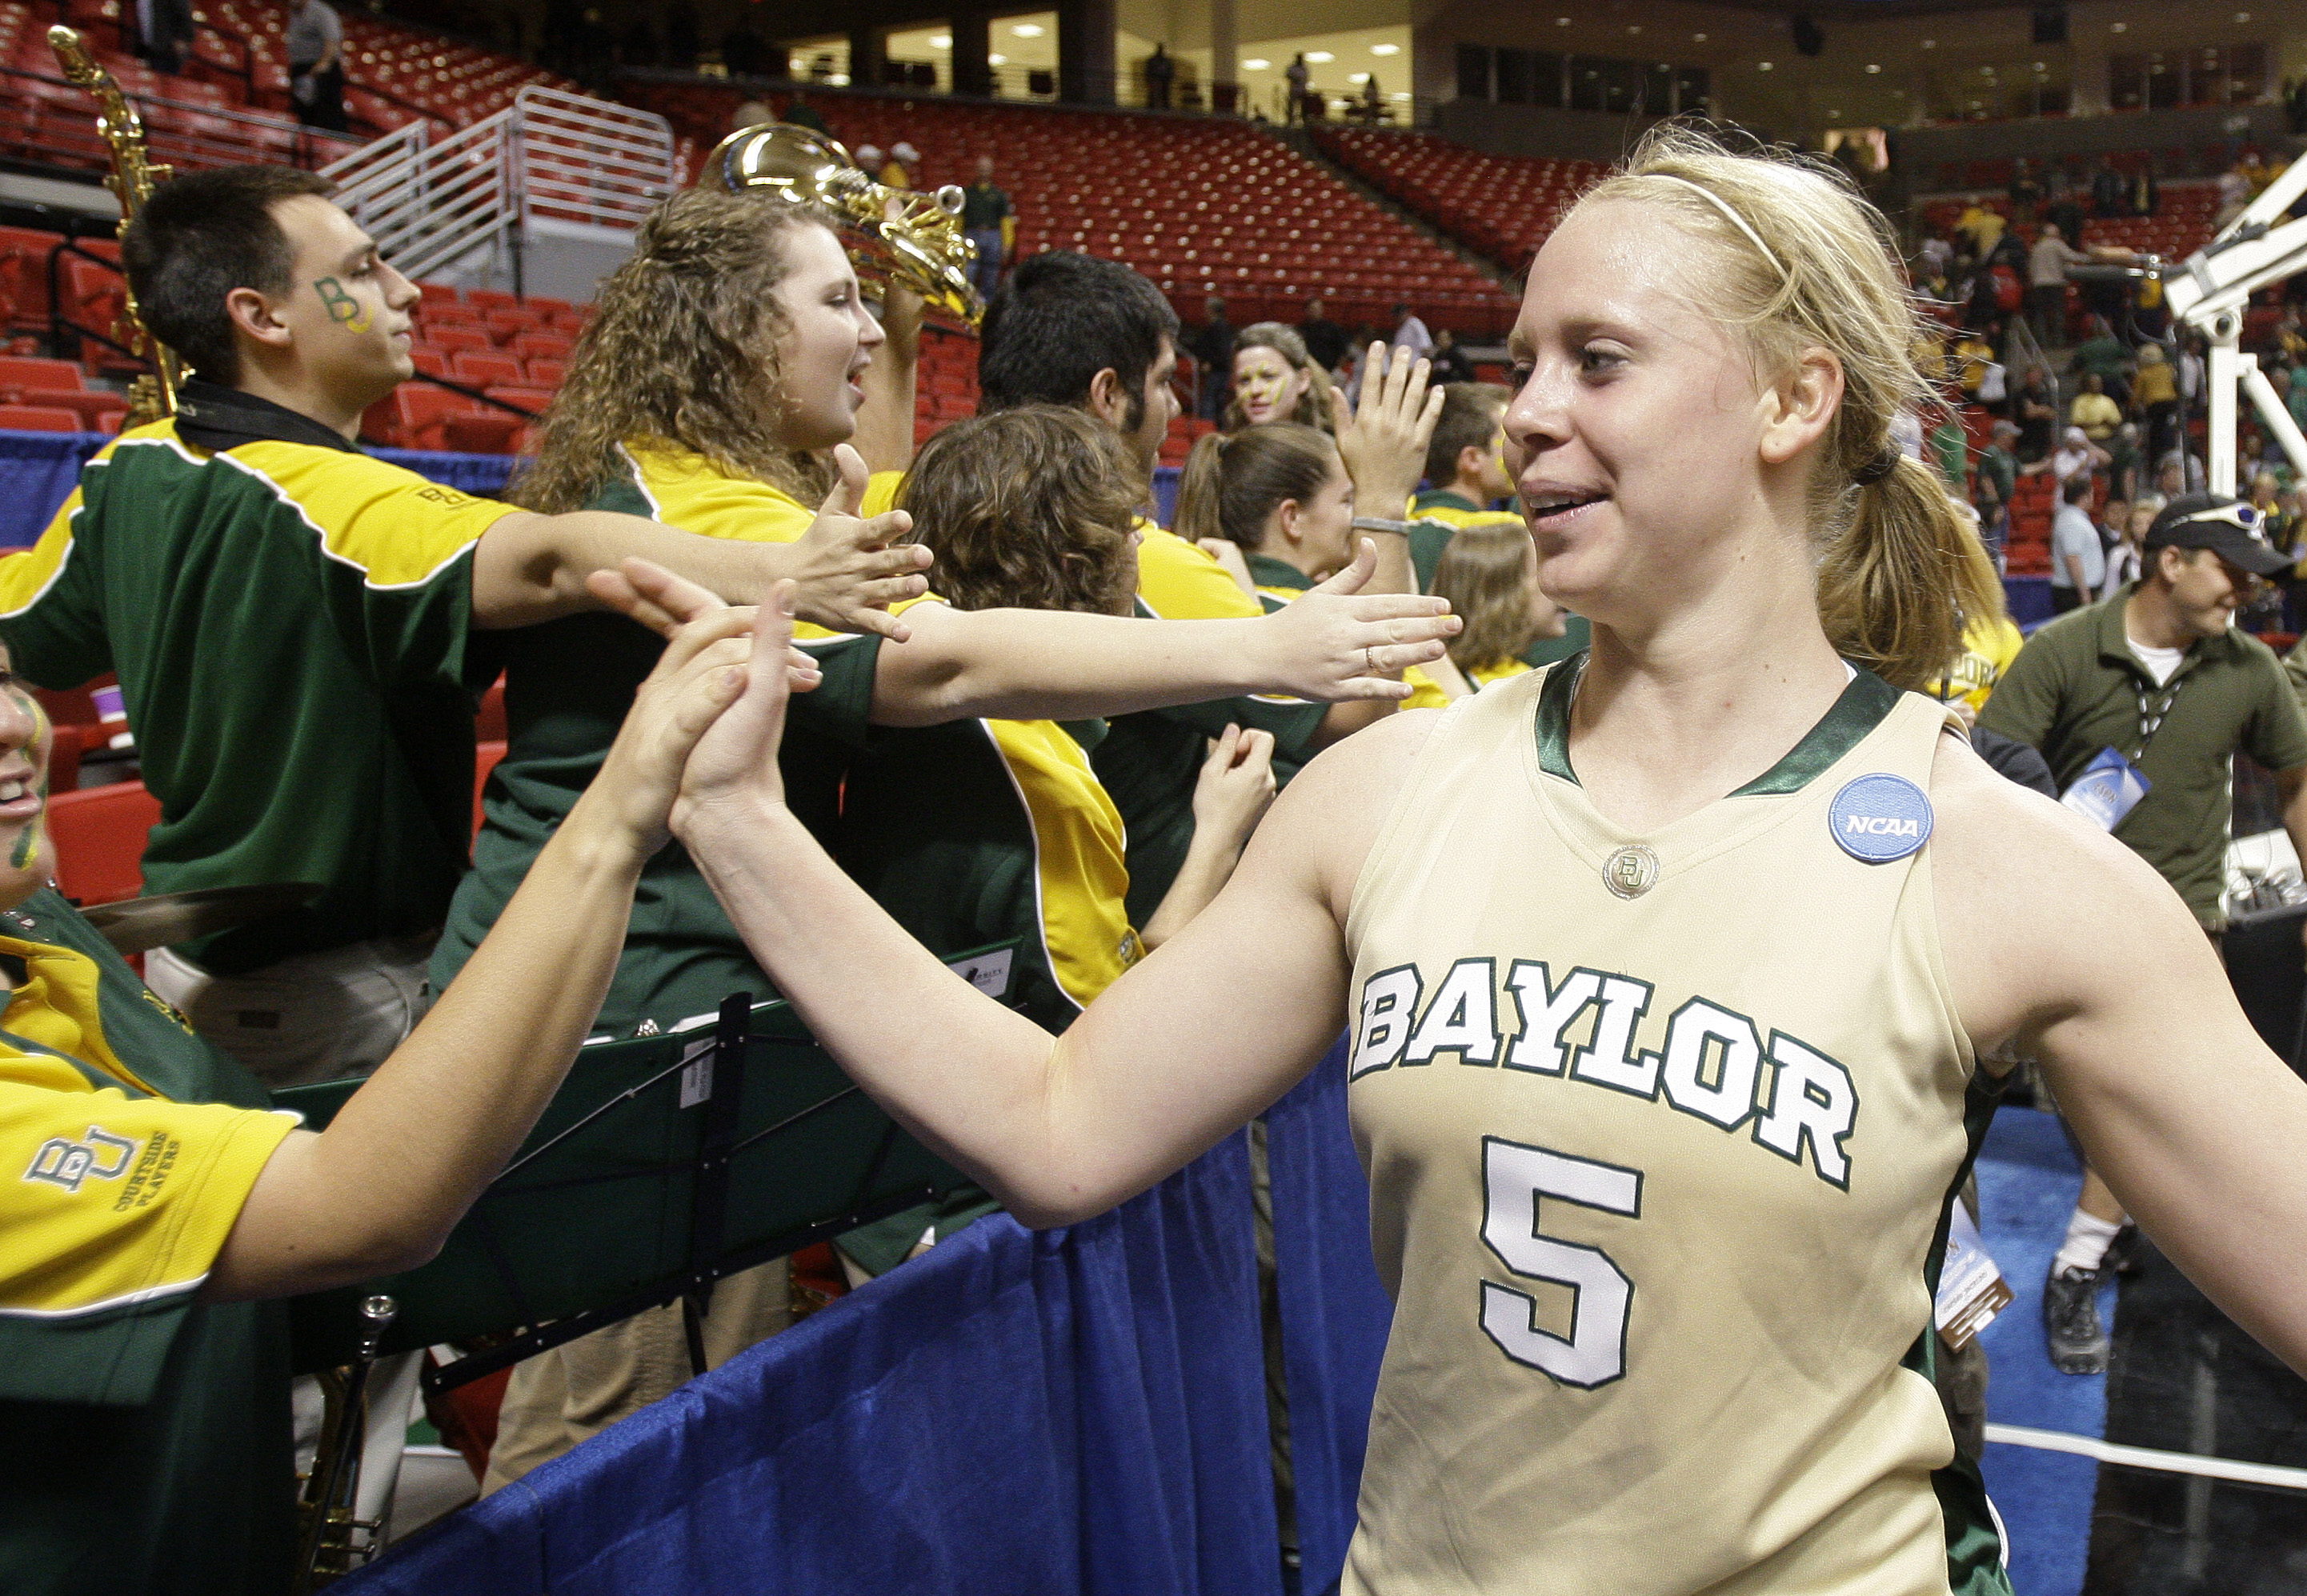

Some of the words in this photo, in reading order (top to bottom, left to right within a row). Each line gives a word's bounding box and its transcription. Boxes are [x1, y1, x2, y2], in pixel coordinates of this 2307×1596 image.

[1845, 814, 1919, 838] NCAA
[1618, 854, 1644, 887] BU
[1348, 956, 1860, 1192] BAYLOR
[22, 1125, 136, 1194] BU
[1479, 1134, 1644, 1391] 5
